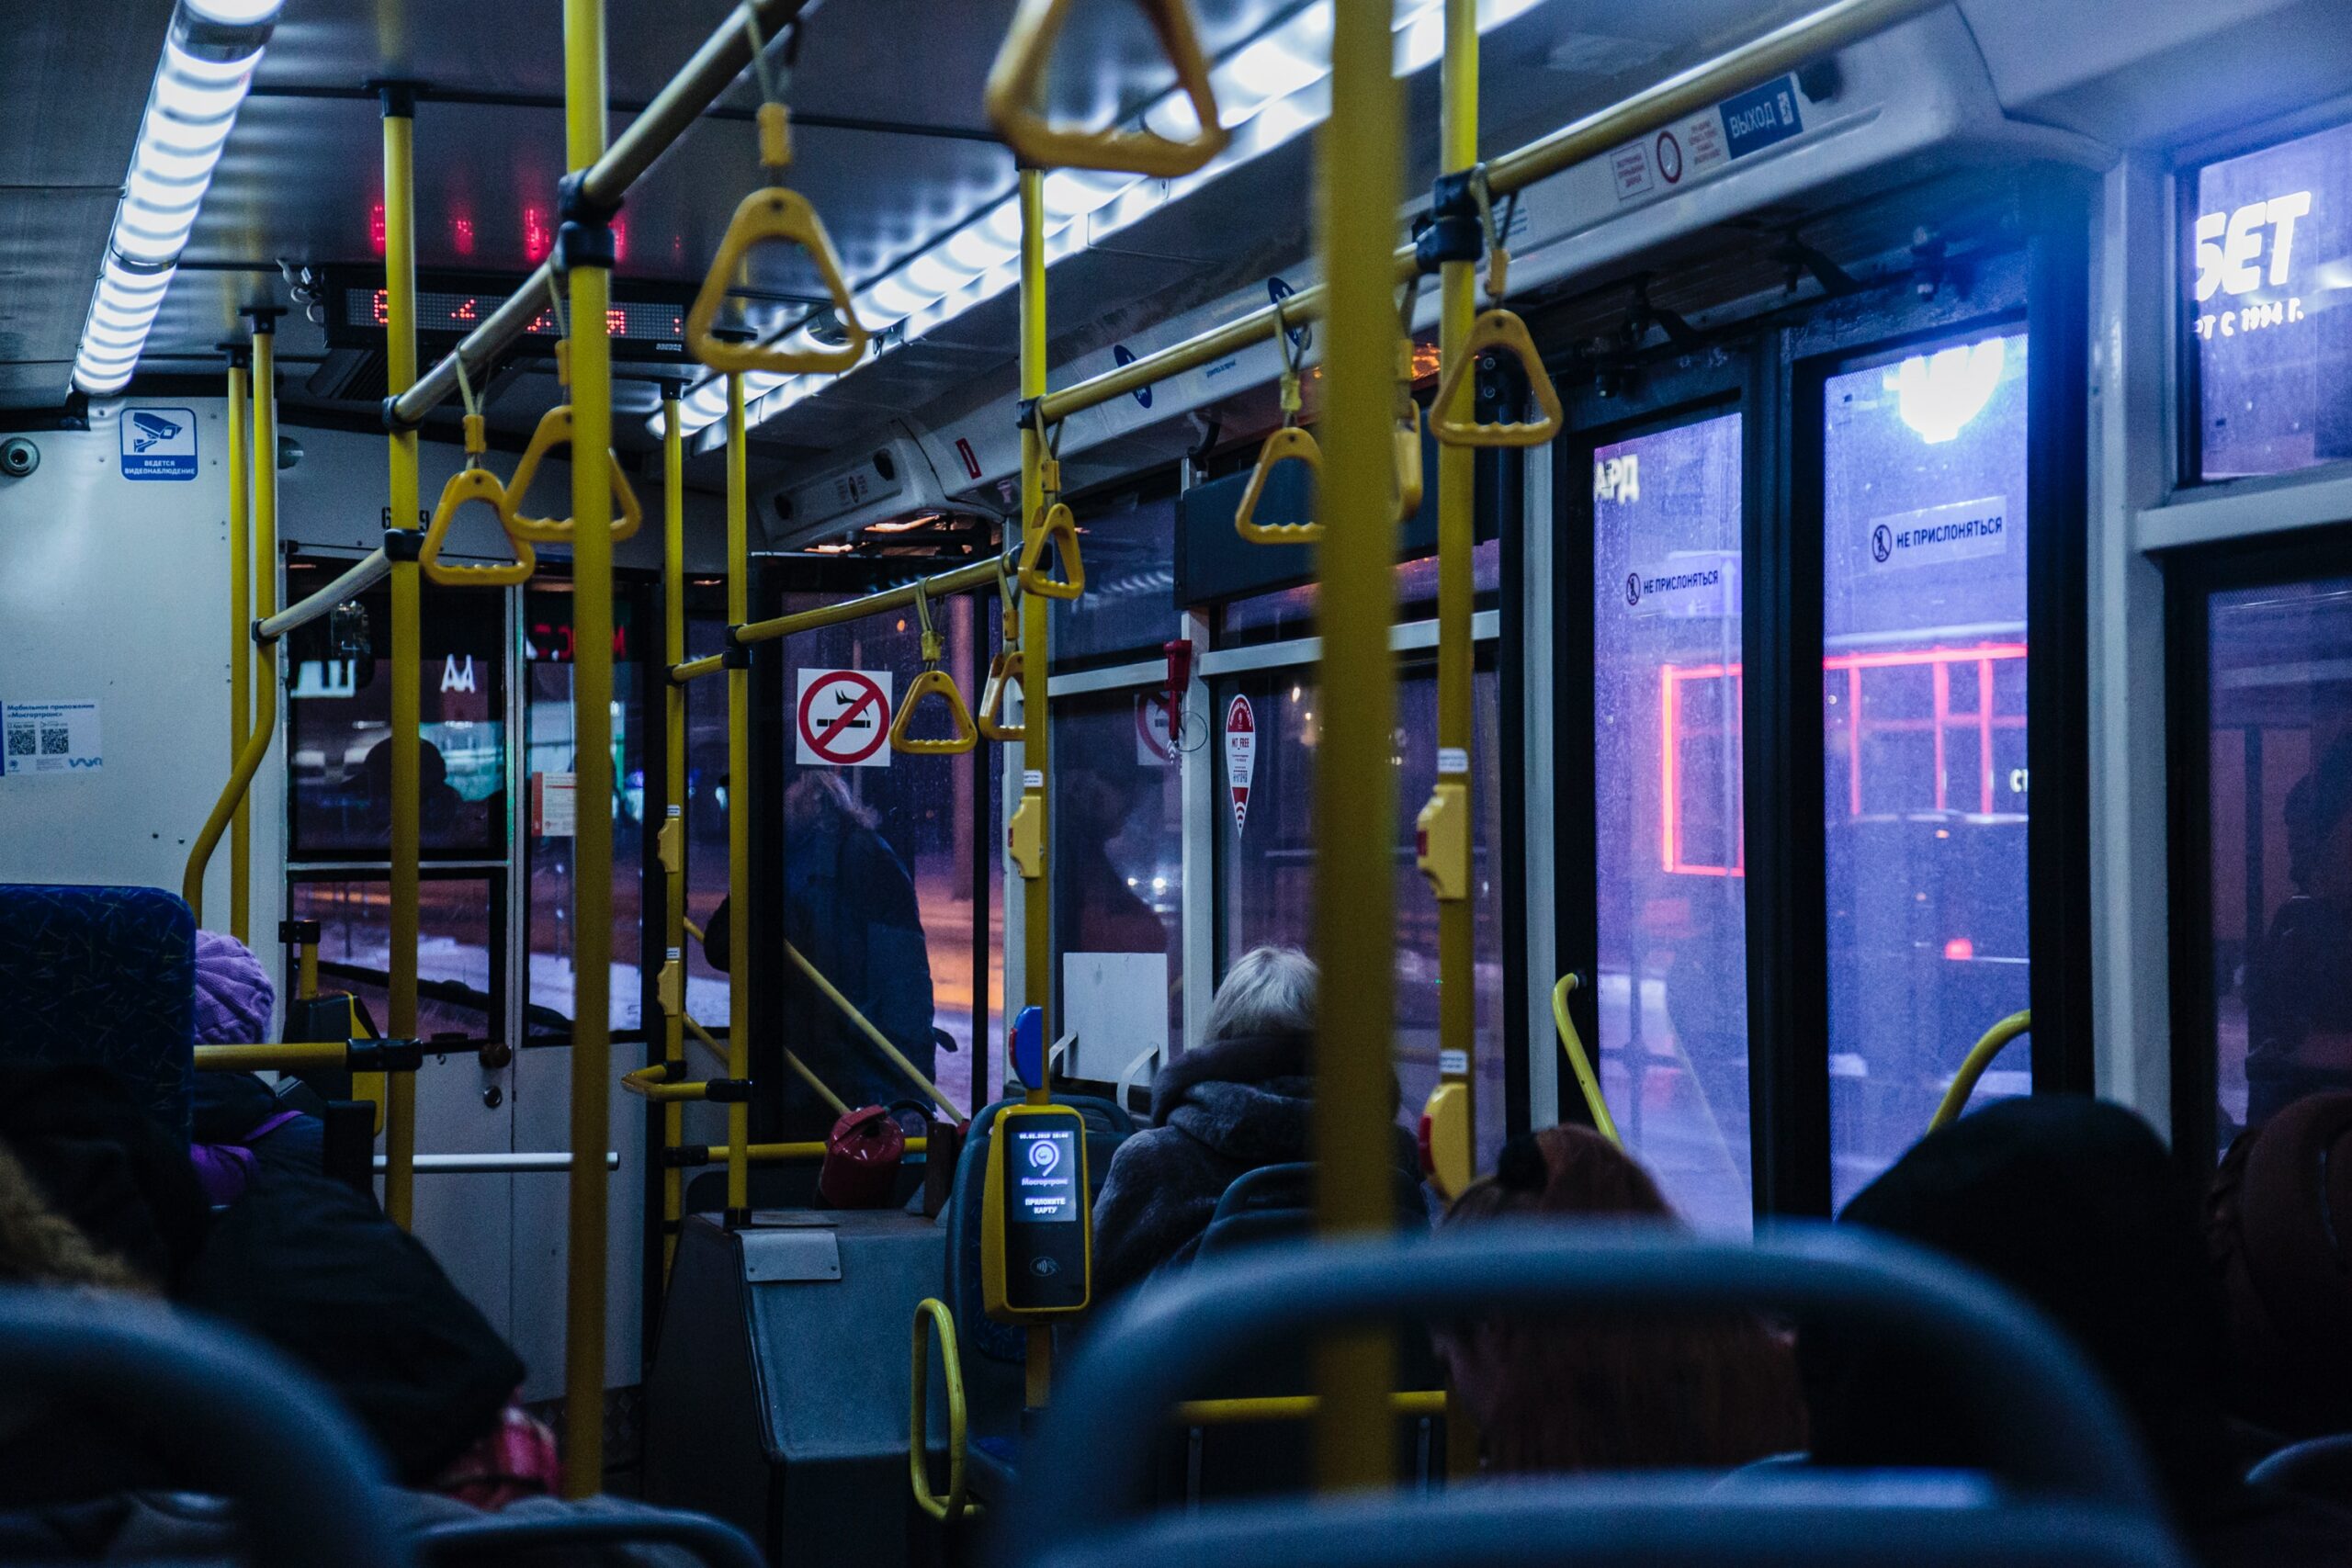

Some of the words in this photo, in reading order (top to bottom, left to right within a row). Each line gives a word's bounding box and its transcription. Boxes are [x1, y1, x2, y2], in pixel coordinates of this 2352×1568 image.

[1729, 101, 1777, 139] ВЫХОД
[1896, 531, 1911, 549] НЕ
[1913, 515, 2003, 547] ПРИСЛОНЯТЬСЯ
[1643, 579, 1655, 595] НЕ
[1655, 570, 1719, 592] ПРИСЛОНЯТЬСЯ
[1034, 1206, 1057, 1214] КАРТУ
